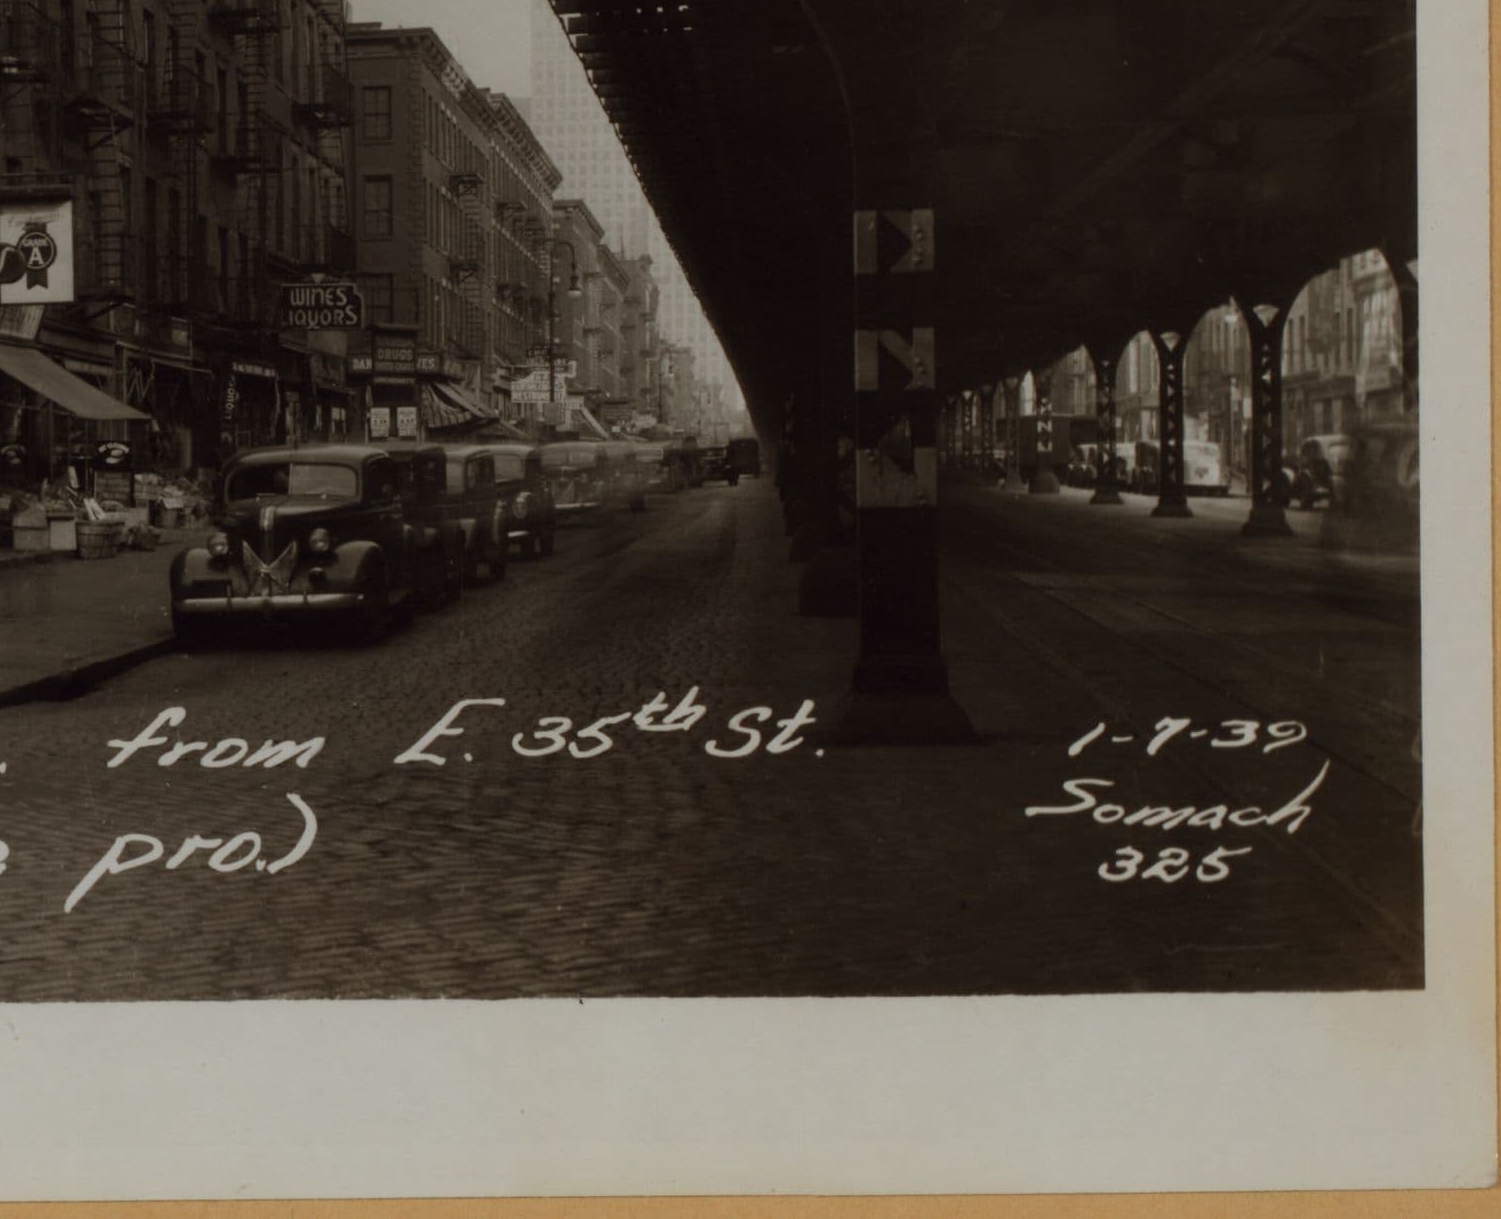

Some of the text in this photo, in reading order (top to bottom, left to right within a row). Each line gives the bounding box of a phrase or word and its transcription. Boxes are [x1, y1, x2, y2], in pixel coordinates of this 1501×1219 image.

[28, 246, 44, 264] A
[290, 287, 348, 307] WINES
[282, 304, 358, 330] LIQUORS
[377, 347, 414, 361] DRUGS
